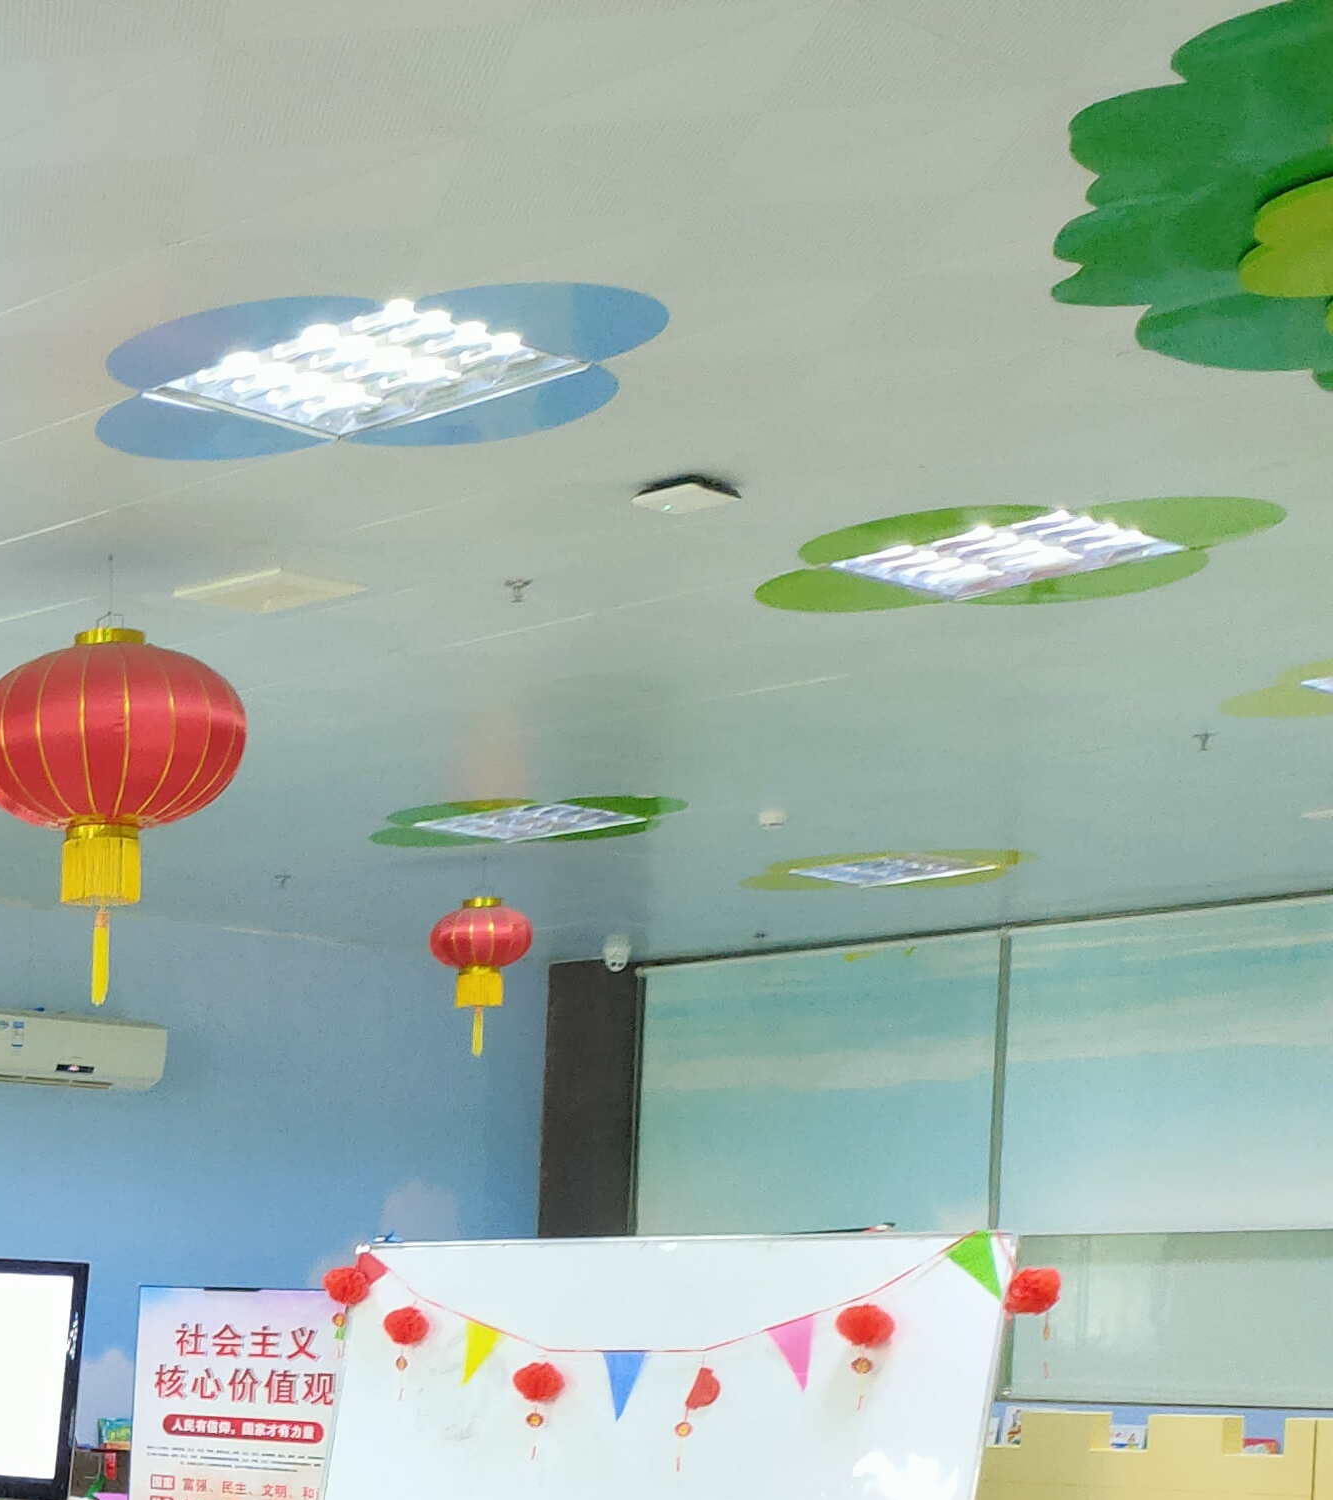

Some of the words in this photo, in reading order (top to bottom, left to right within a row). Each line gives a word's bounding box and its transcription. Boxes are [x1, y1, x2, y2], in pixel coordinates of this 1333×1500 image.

[175, 1323, 320, 1361] 社会主义
[154, 1364, 336, 1407] 核心价值观
